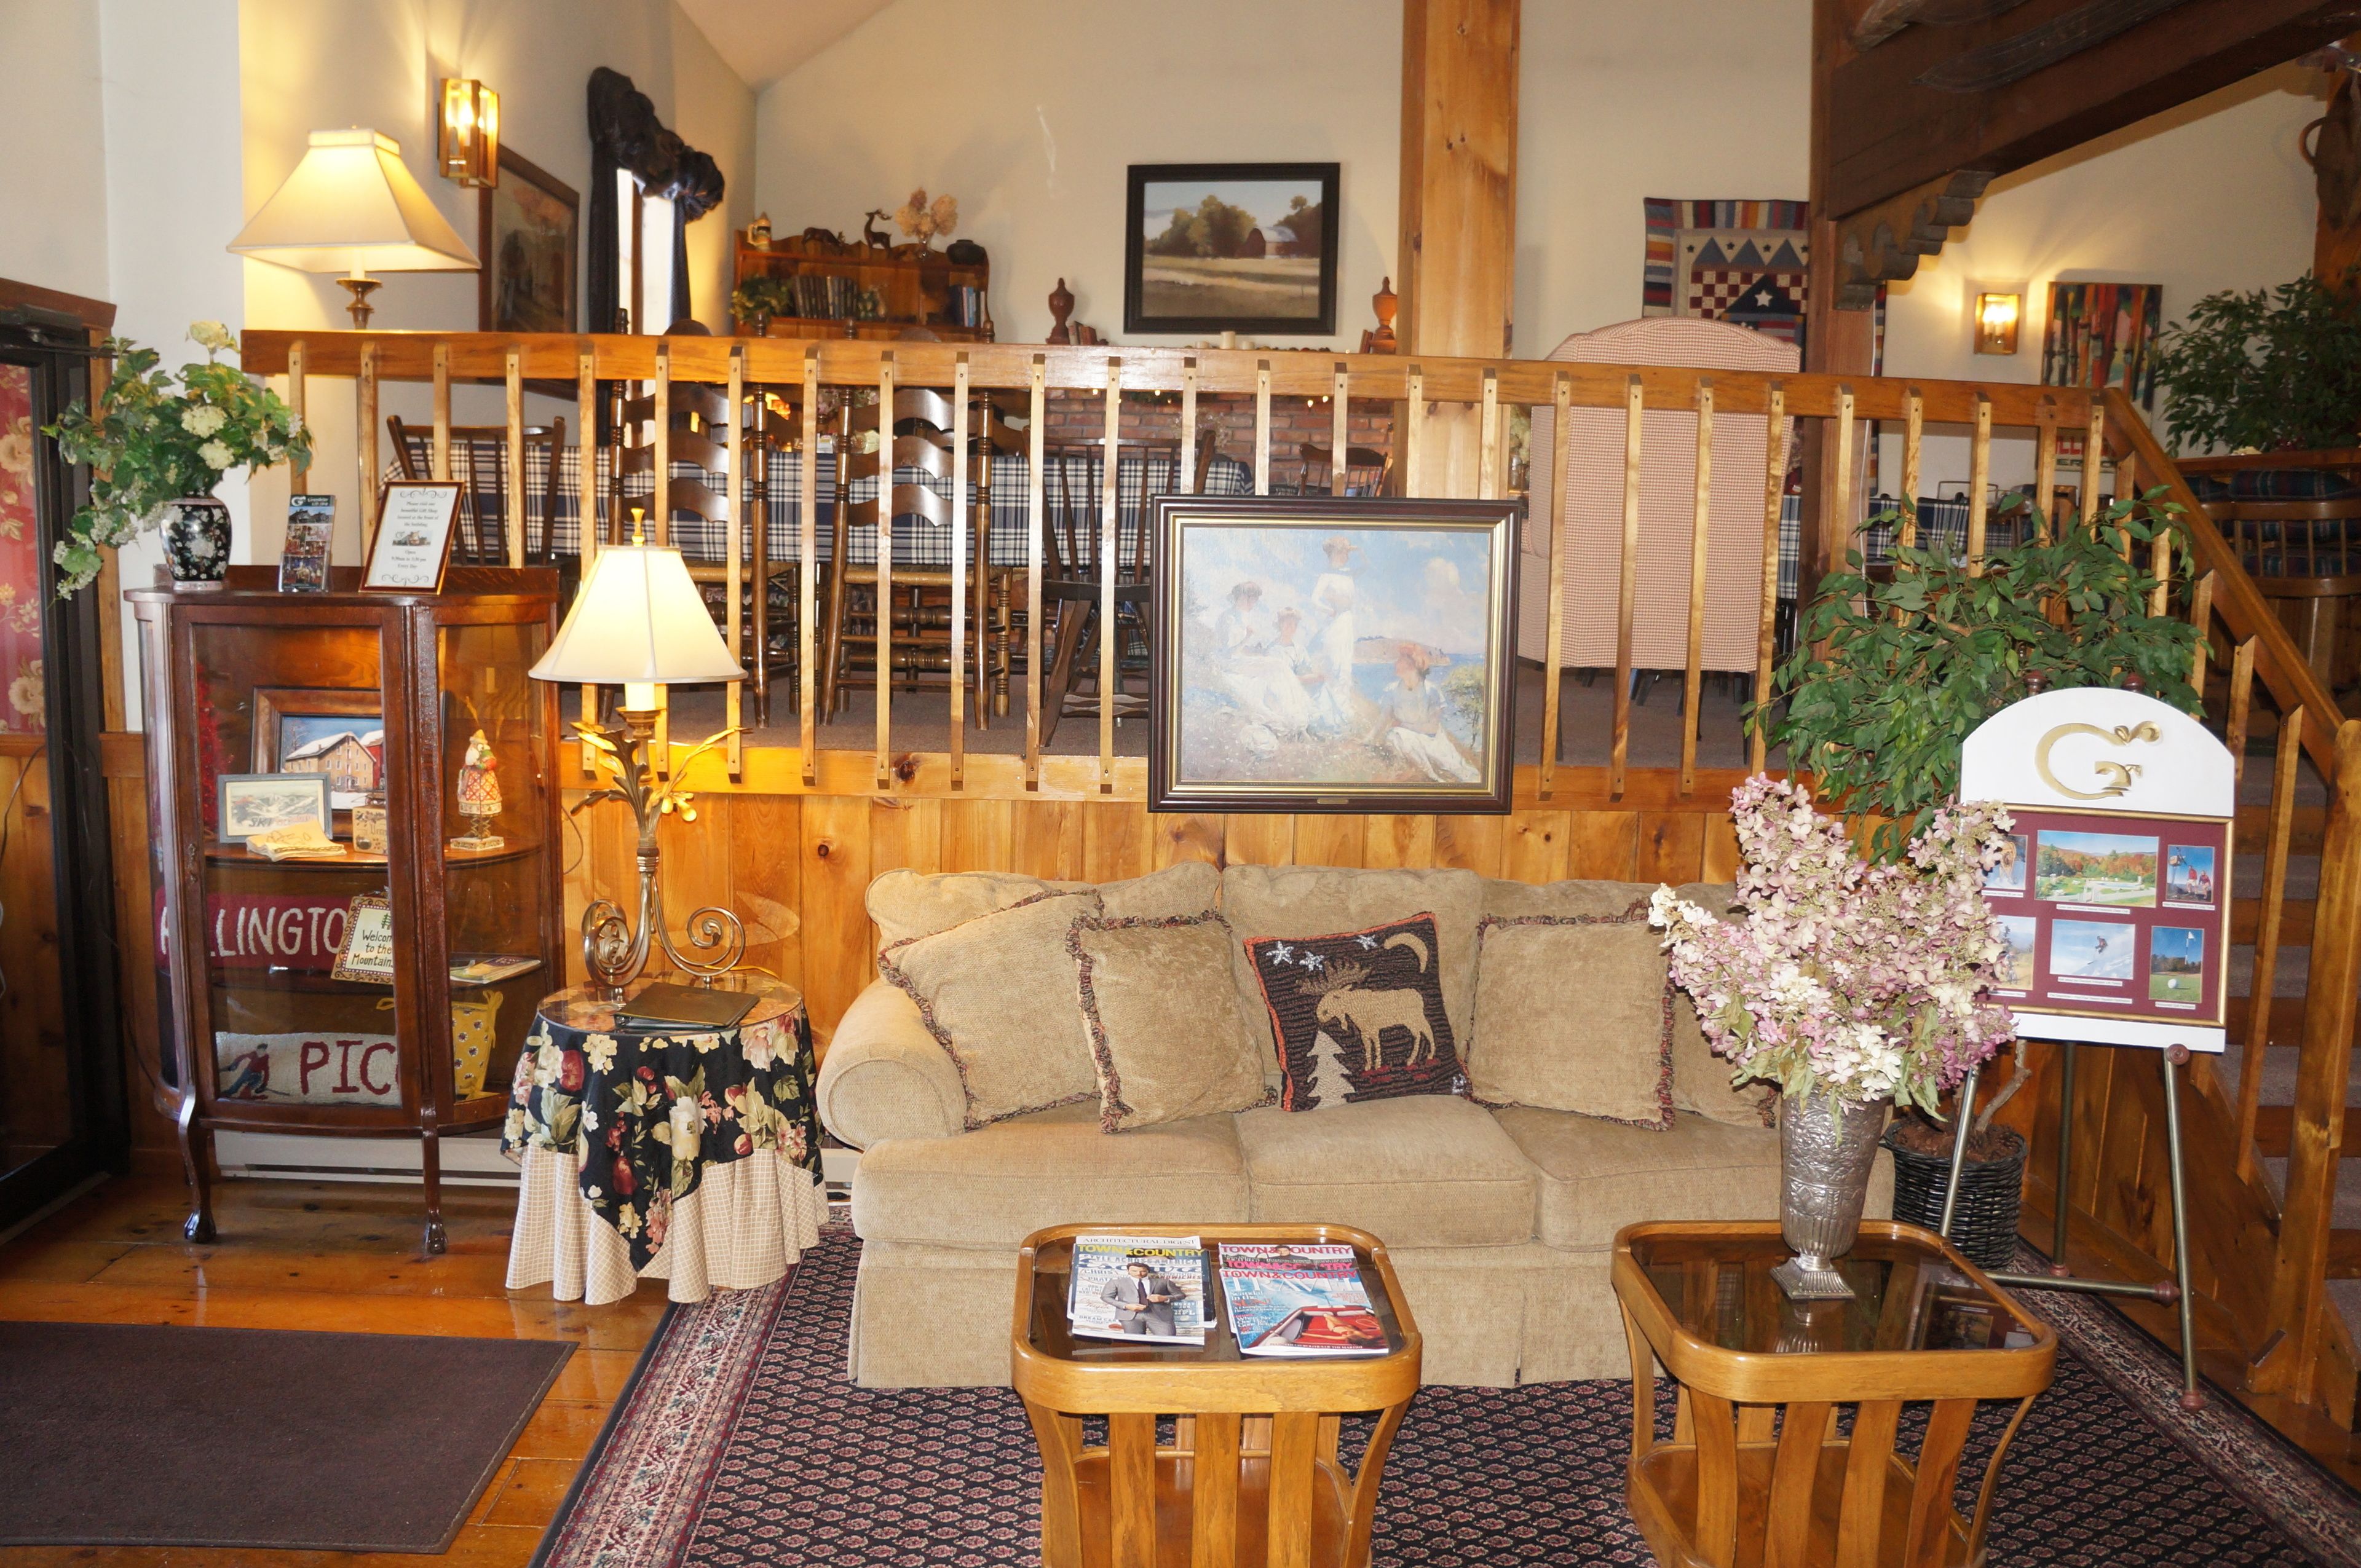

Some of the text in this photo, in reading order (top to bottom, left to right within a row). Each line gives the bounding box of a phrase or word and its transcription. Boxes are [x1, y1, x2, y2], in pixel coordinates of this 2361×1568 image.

[366, 943, 392, 955] to the
[351, 953, 394, 968] Mountain
[300, 1040, 401, 1095] PIC
[1221, 1270, 1357, 1280] TOWN&COUNTRY
